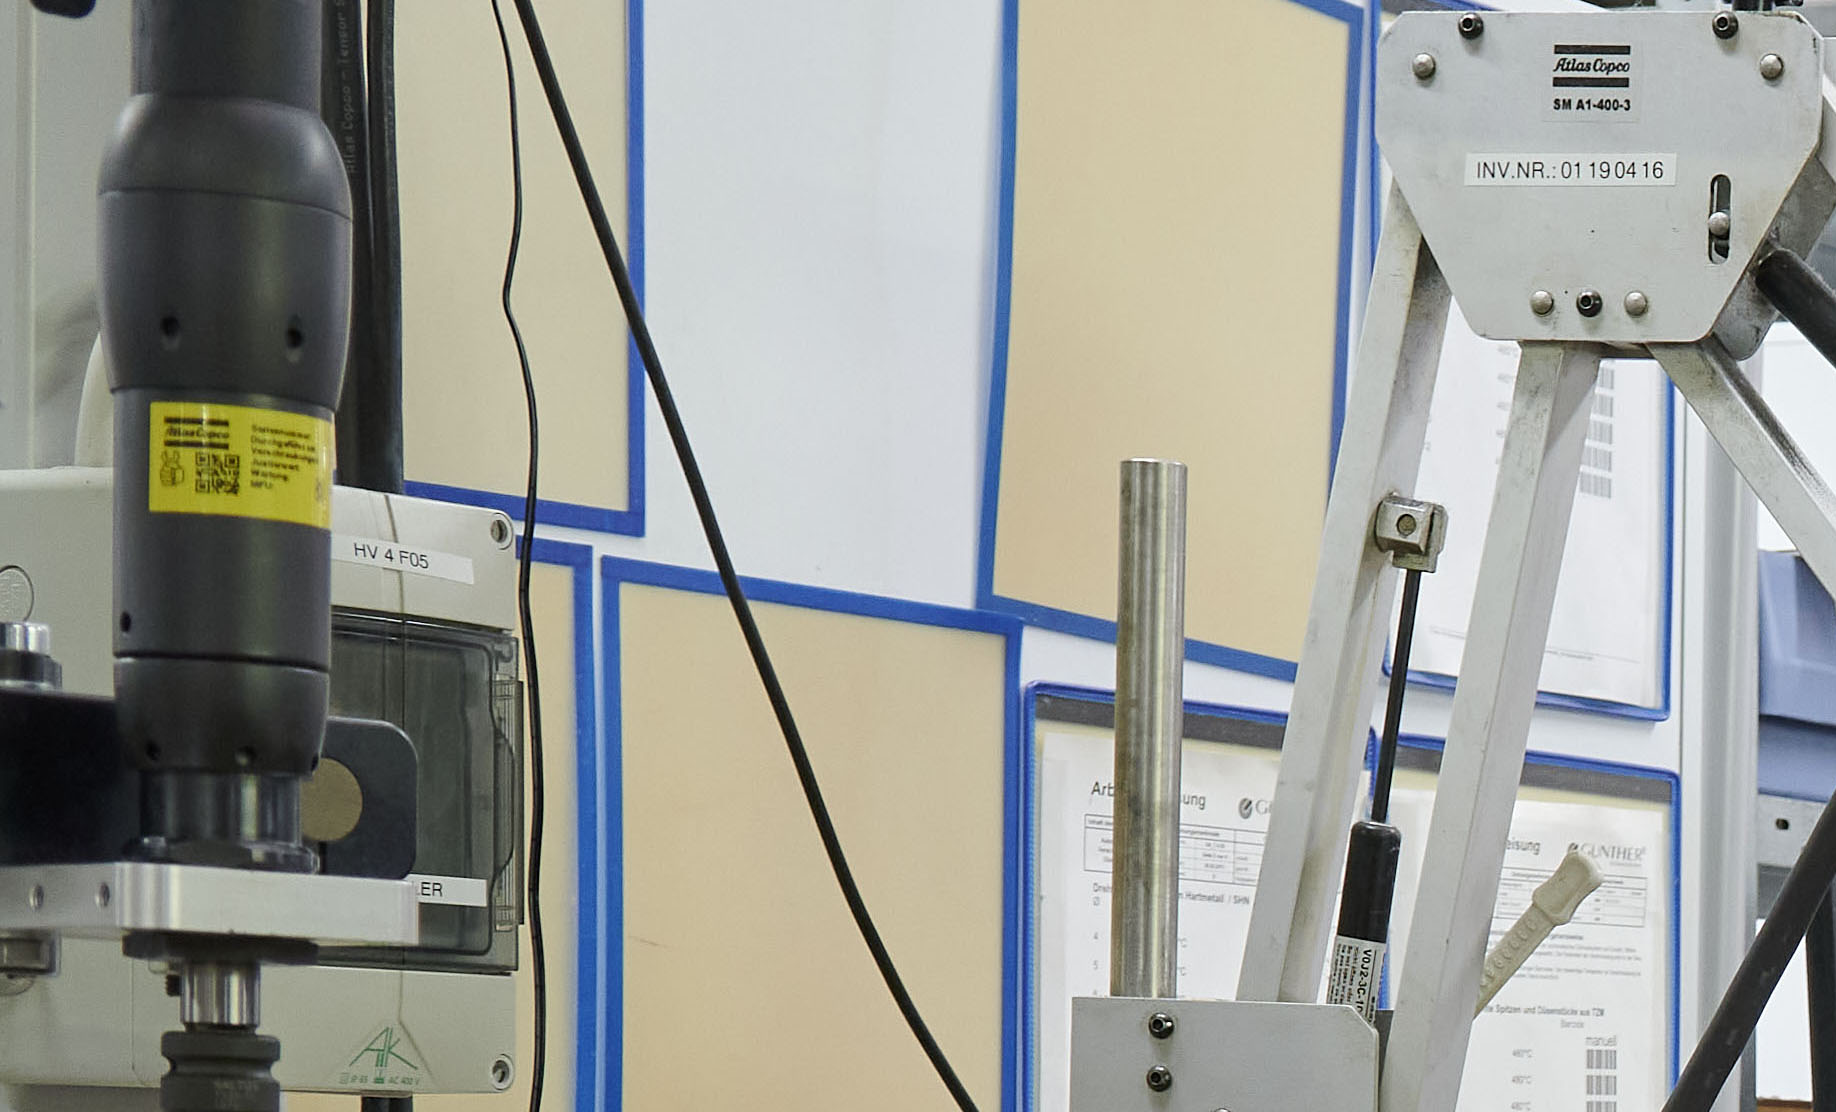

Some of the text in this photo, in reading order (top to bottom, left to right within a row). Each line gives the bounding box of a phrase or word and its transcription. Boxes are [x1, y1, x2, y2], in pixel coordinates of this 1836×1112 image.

[1553, 58, 1630, 76] Atlas Copco
[1553, 99, 1631, 112] SM A1-400-3
[354, 542, 429, 569] HV 4 F05
